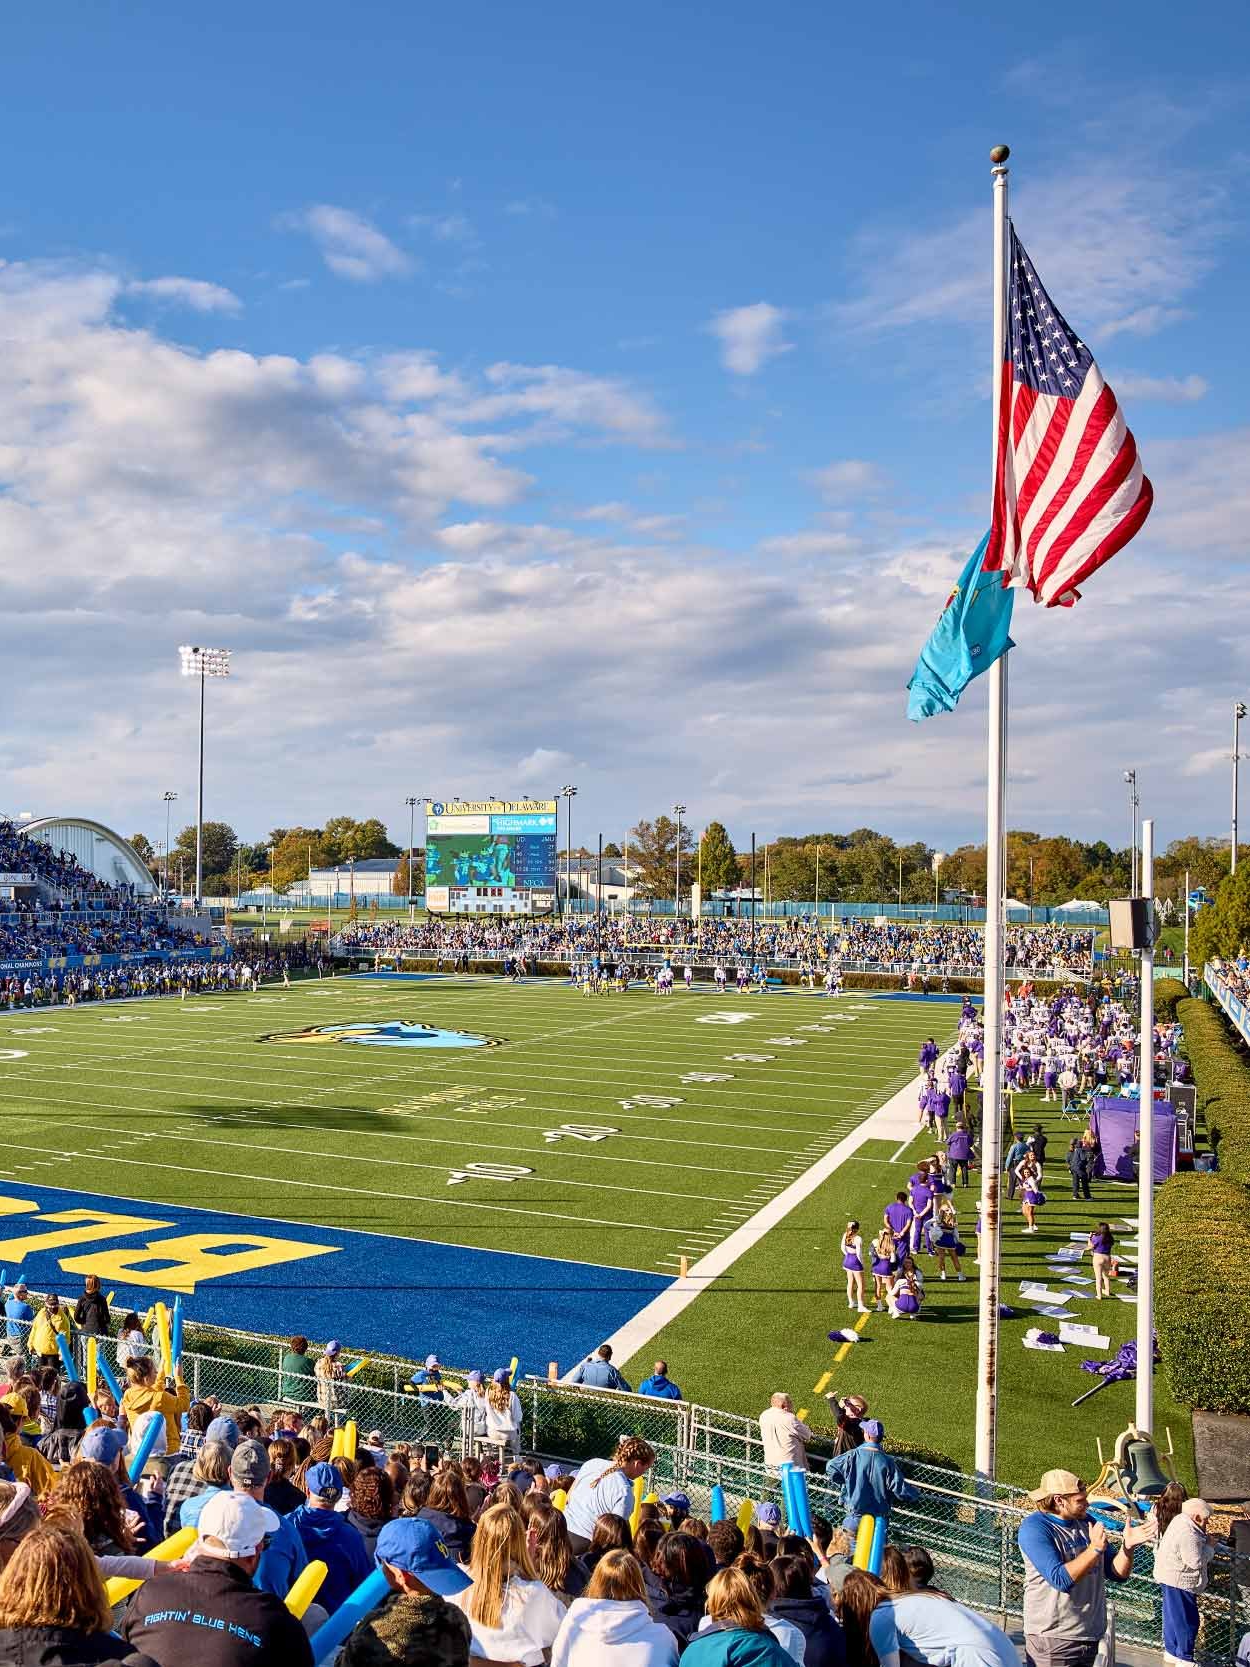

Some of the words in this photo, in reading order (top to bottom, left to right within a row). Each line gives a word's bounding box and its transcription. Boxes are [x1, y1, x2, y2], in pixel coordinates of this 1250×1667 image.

[445, 802, 494, 814] UNIVERSITY
[503, 801, 550, 812] DELAWARE
[14, 960, 42, 969] CHAMPIONS
[453, 1096, 527, 1114] FIELD
[543, 1124, 622, 1142] 20
[450, 1162, 536, 1183] 10
[144, 1610, 191, 1626] FIGHTIN'
[193, 1614, 225, 1630] BLUE
[228, 1623, 261, 1647] HENS
